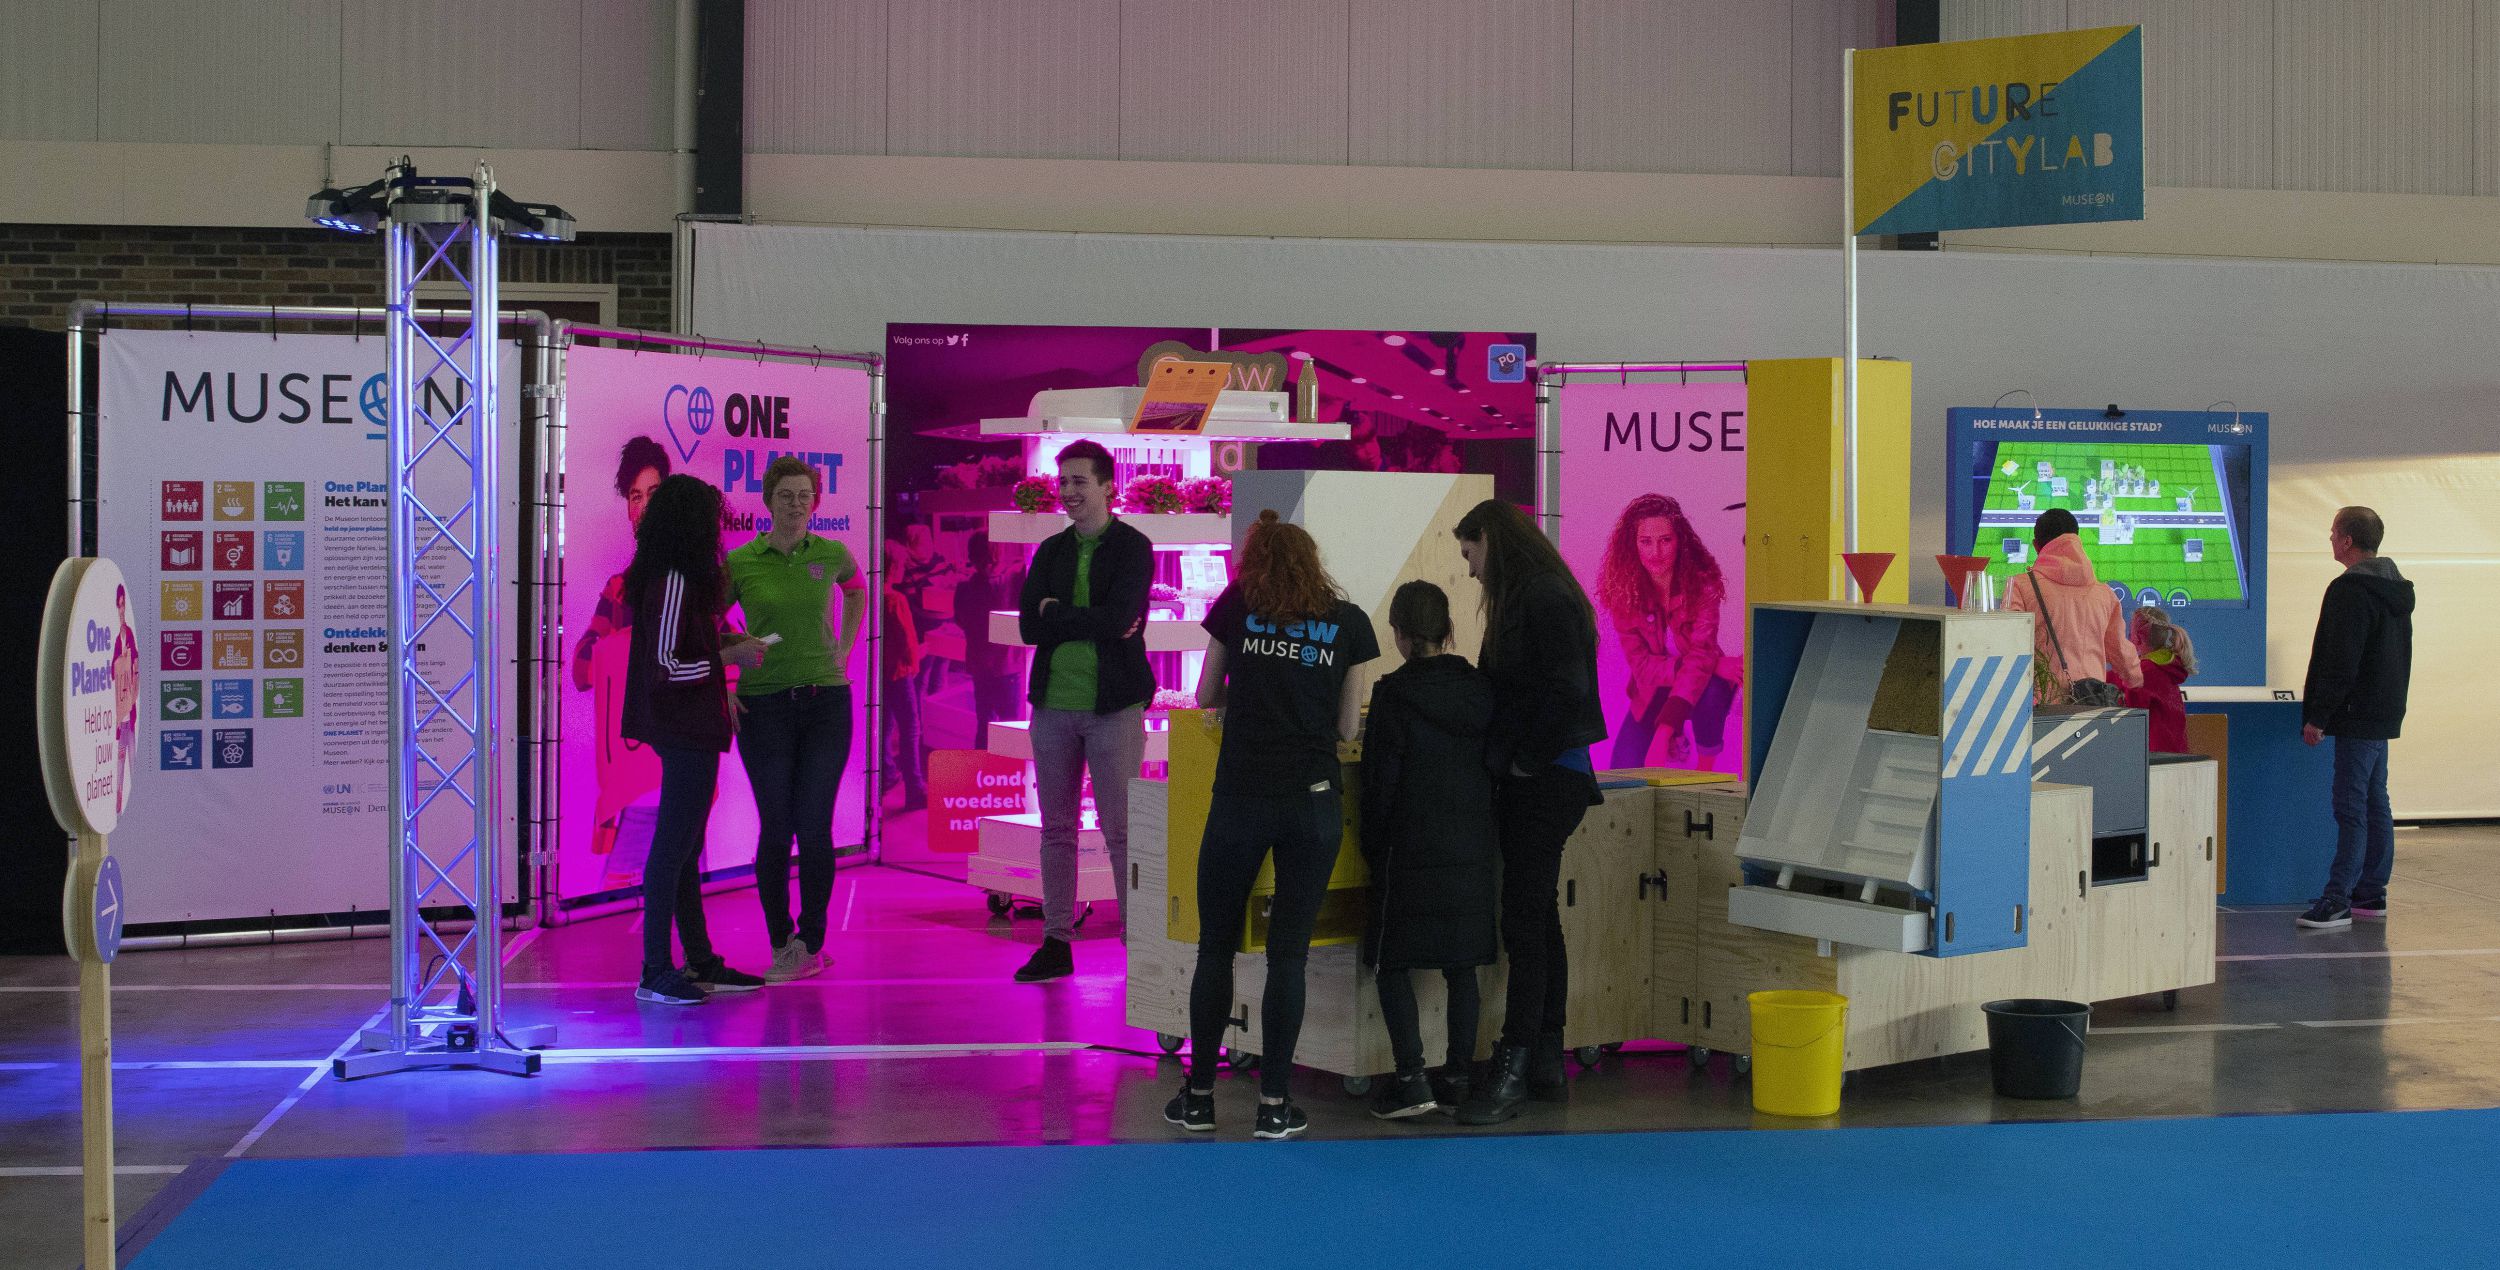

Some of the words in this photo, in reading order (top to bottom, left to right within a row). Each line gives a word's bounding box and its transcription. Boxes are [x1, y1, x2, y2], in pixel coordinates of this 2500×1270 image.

[1888, 83, 2059, 131] FUTURE
[1931, 133, 2114, 181] CITYLAB
[2062, 193, 2115, 207] MUSEON
[893, 336, 913, 346] Volg
[932, 338, 944, 346] op
[724, 392, 790, 439] ONE
[1974, 419, 1996, 429] HOE
[1998, 420, 2030, 430] MAAK
[2032, 420, 2044, 430] JE
[2046, 420, 2066, 430] EEN
[2068, 421, 2128, 431] GELUKKIGE
[2130, 422, 2163, 432] STAD?
[217, 484, 222, 493] 2
[268, 484, 273, 493] 3
[324, 481, 354, 492] One
[324, 496, 352, 507] Het
[353, 496, 379, 507] kan
[723, 513, 753, 531] Held
[755, 517, 773, 531] op
[86, 619, 112, 654] One
[163, 634, 172, 643] 10
[215, 633, 222, 641] 11
[266, 632, 274, 641] 12
[324, 642, 376, 654] denken
[378, 642, 388, 652] &
[1242, 638, 1334, 666] MUSEON
[72, 660, 112, 696] Planet
[163, 683, 171, 692] 13
[84, 704, 102, 734] Held
[103, 710, 112, 736] op
[163, 733, 172, 742] 16
[216, 732, 223, 741] 17
[95, 738, 113, 773] jouw
[86, 770, 113, 808] planeet
[337, 784, 351, 794] UN
[950, 816, 980, 831] nat
